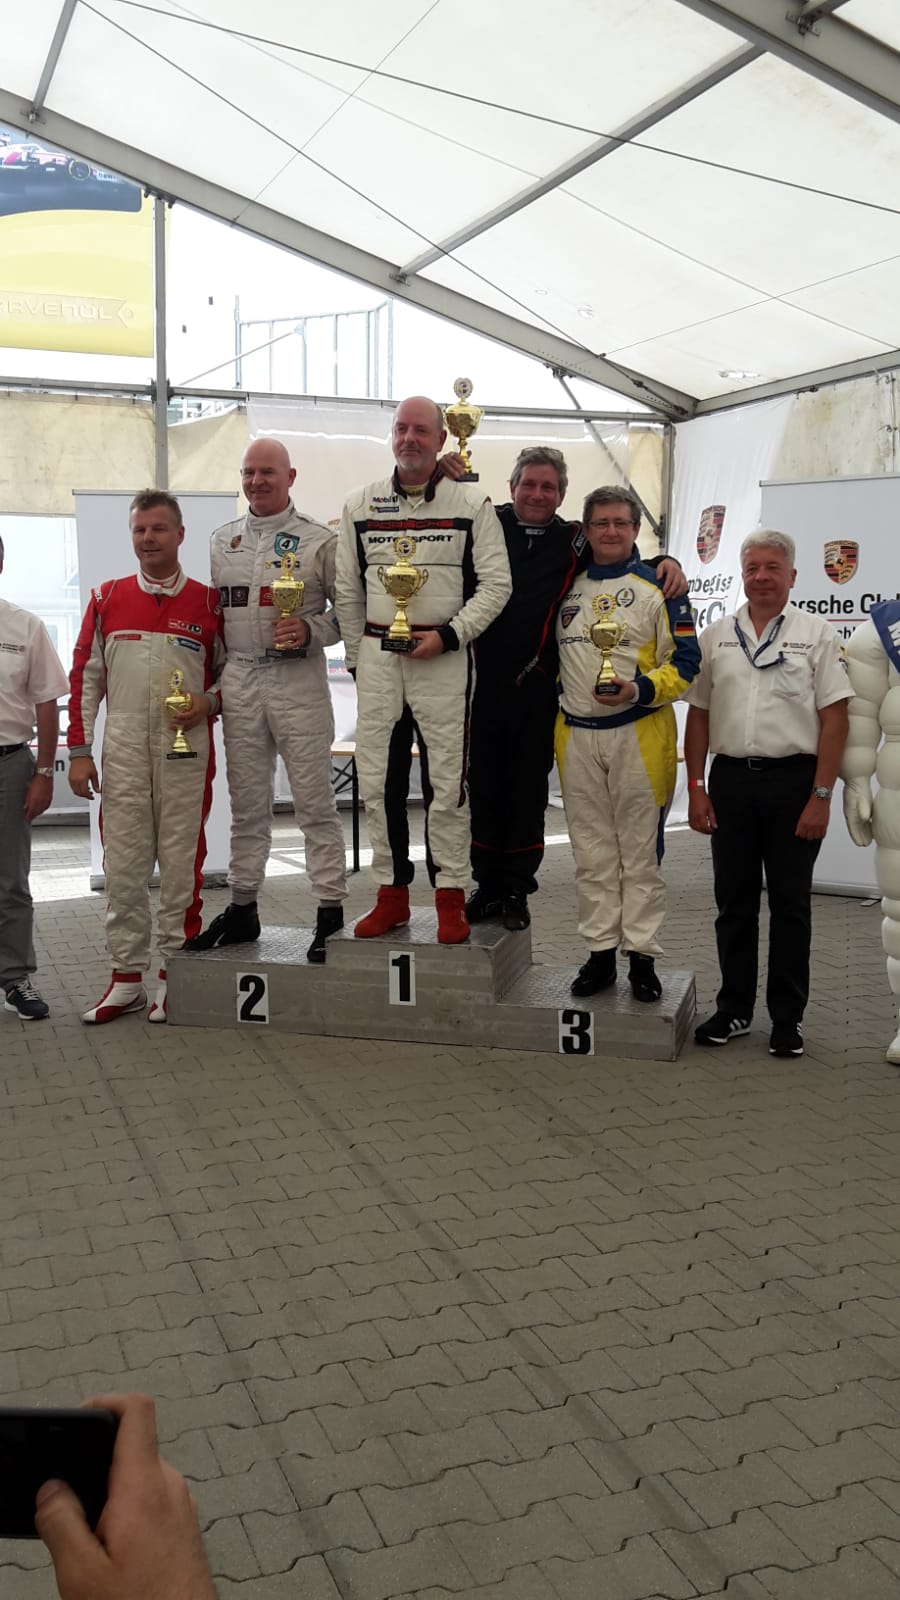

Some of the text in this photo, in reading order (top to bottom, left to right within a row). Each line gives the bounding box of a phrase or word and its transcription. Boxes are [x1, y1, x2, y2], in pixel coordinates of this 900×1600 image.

[281, 540, 291, 549] 4
[239, 975, 267, 1022] 2
[391, 954, 411, 1002] 1
[562, 1009, 591, 1055] 3
